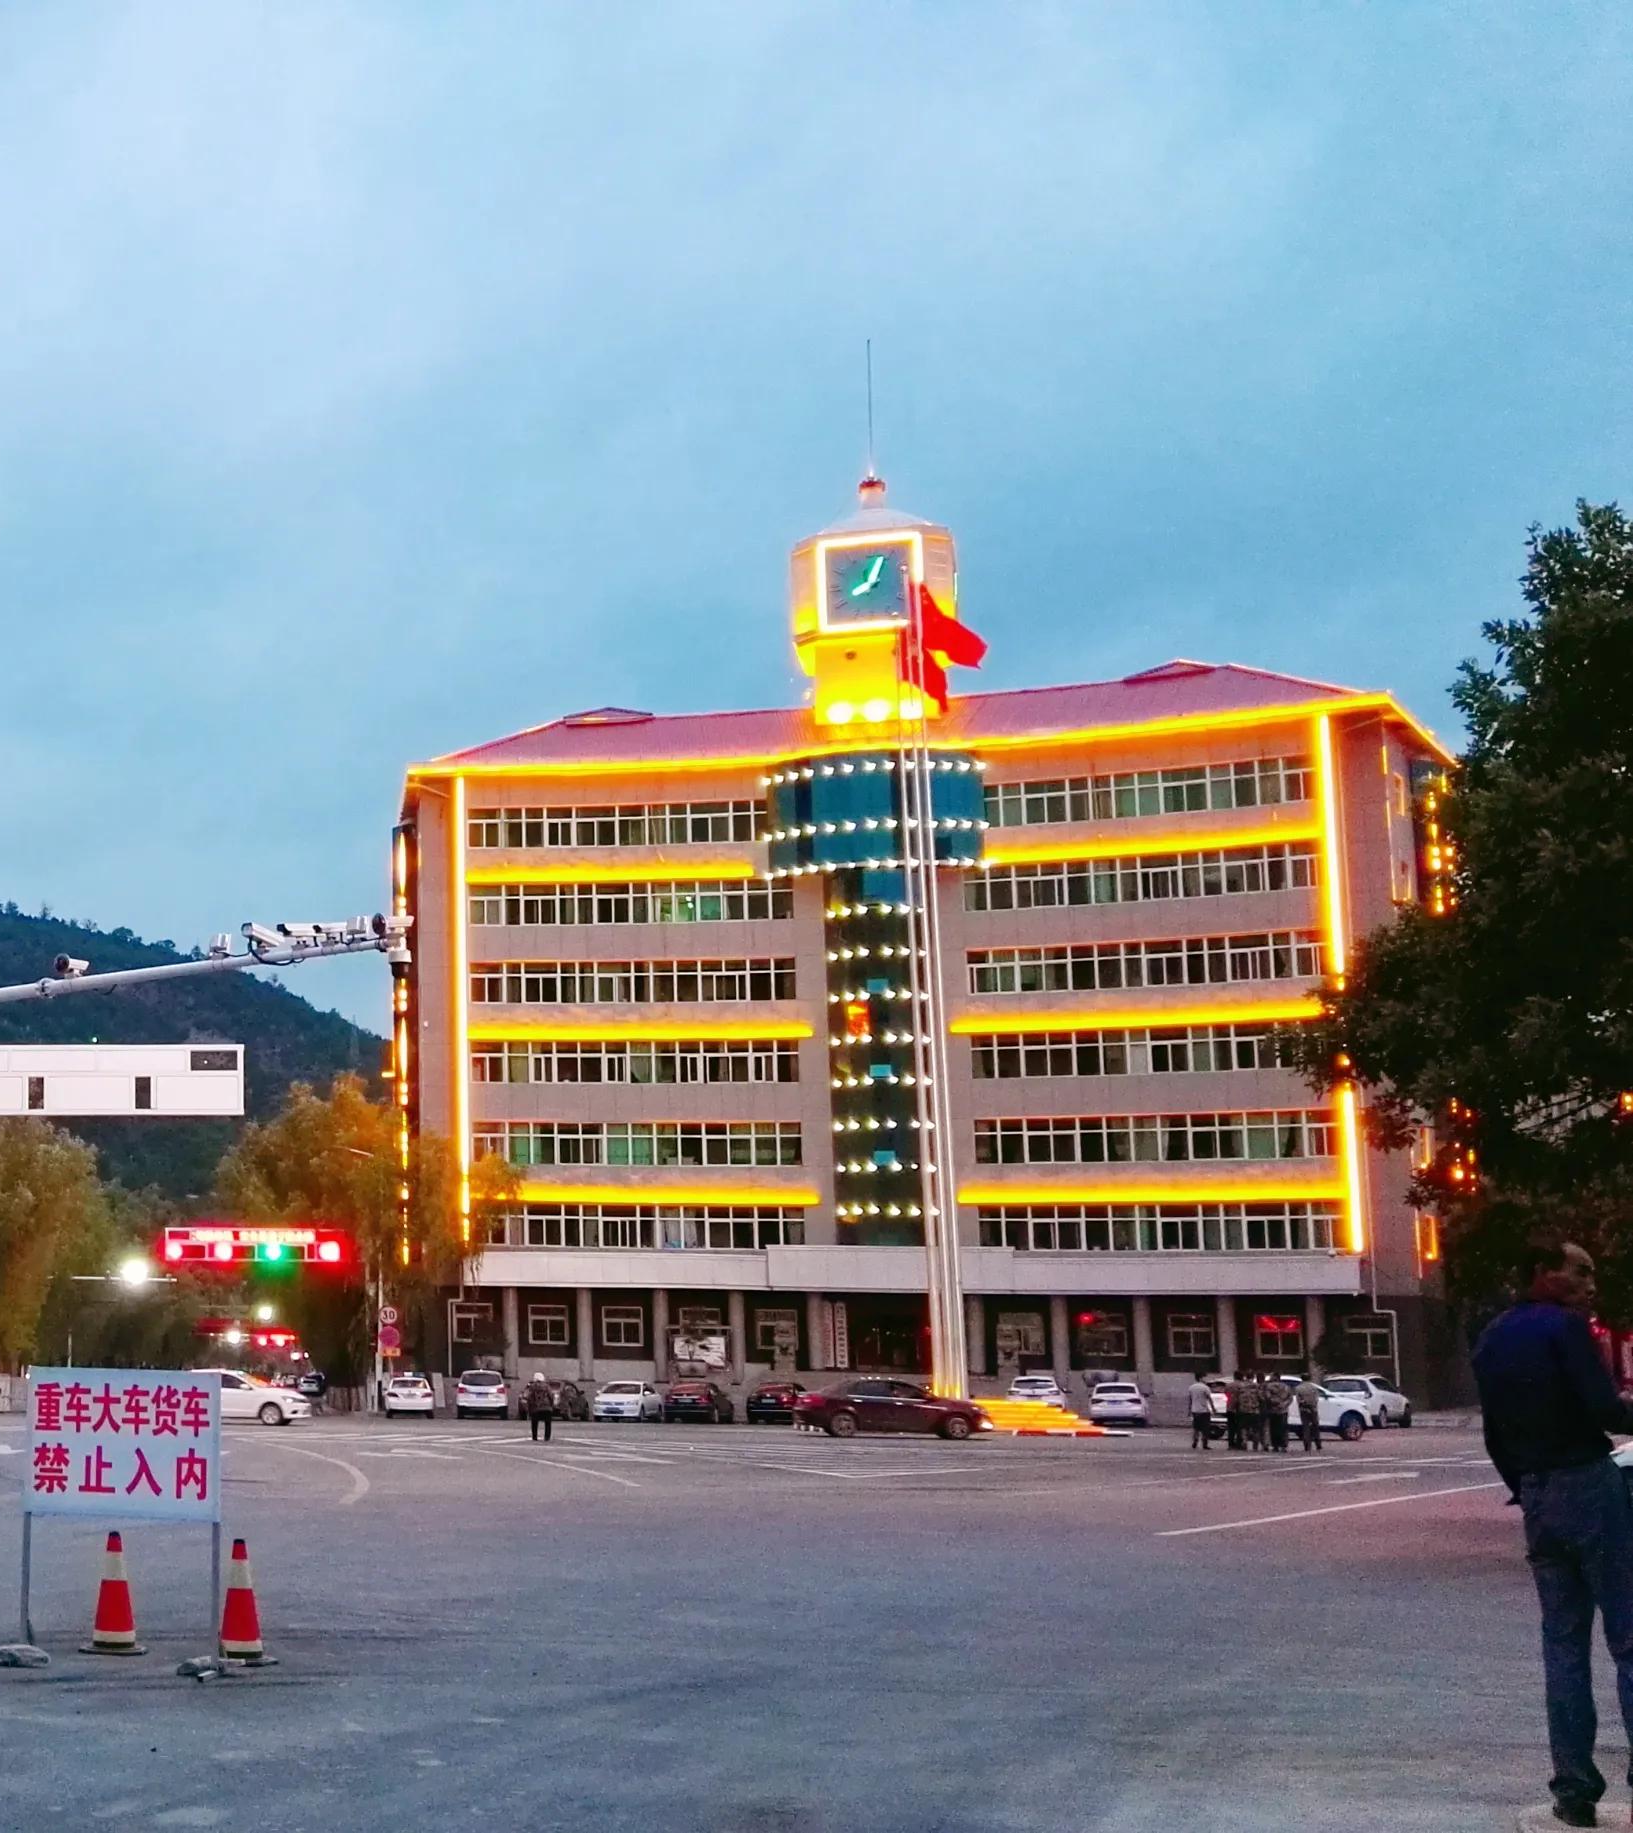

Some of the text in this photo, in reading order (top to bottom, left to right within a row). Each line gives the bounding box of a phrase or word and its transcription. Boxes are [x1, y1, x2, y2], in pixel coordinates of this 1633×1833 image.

[382, 1310, 396, 1320] 30
[33, 1381, 211, 1438] 重车大车货车
[32, 1441, 208, 1501] 禁止入内
